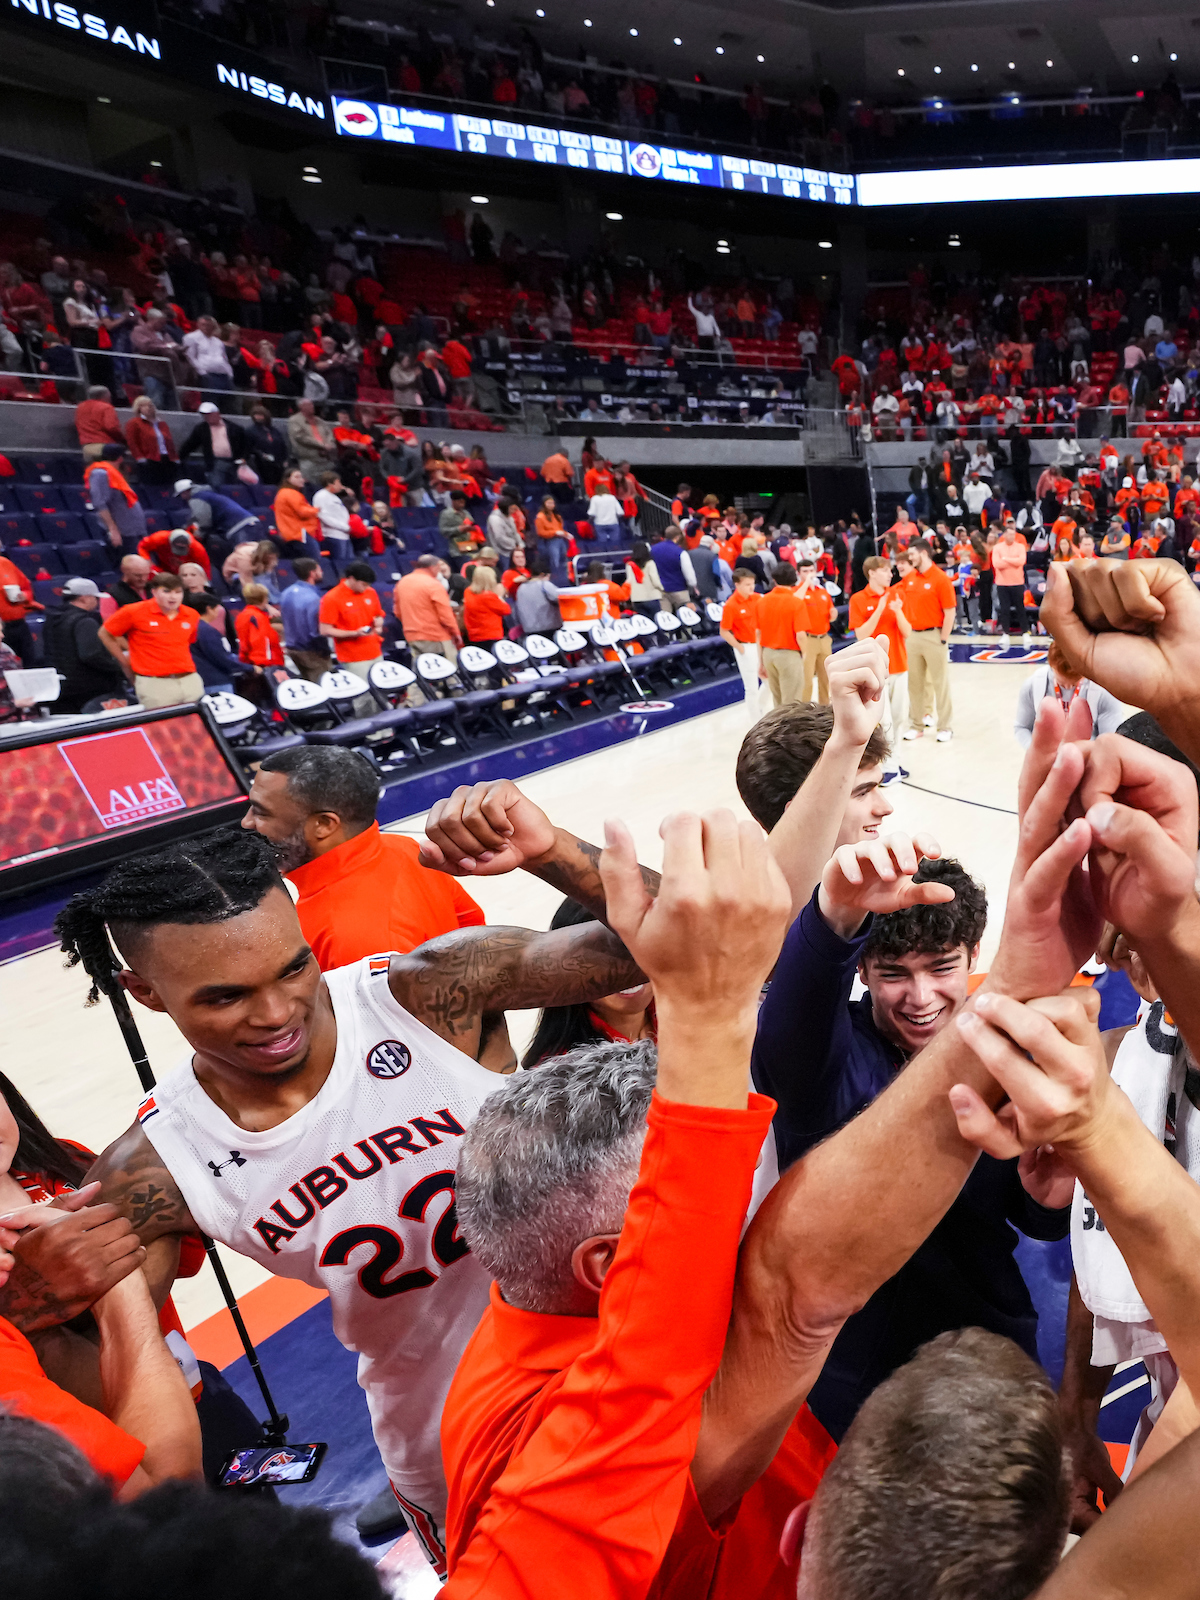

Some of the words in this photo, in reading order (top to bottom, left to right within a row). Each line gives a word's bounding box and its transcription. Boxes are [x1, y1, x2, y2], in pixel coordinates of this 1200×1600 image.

[216, 63, 325, 119] NISSAN
[109, 777, 177, 812] ALFA
[369, 1042, 410, 1077] SEC
[253, 1108, 467, 1255] AUBURN
[319, 1169, 472, 1299] 22
